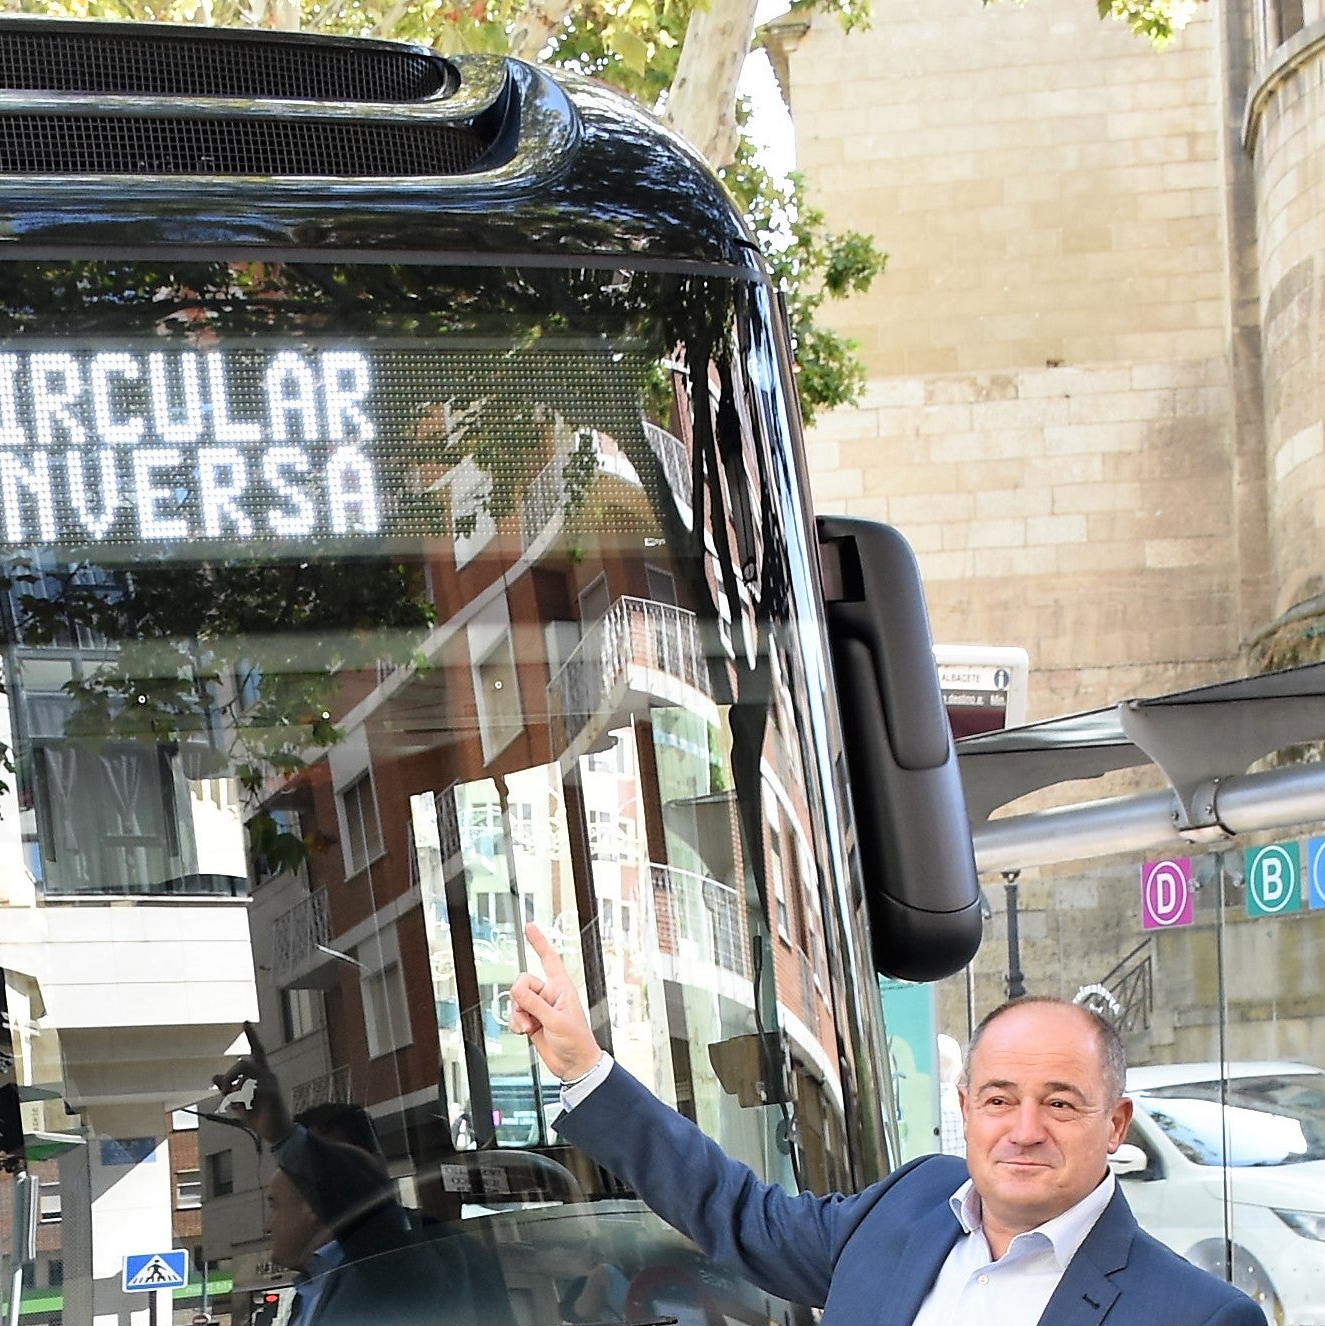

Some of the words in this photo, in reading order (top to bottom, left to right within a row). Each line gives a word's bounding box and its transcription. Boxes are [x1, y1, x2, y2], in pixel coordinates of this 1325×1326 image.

[941, 673, 980, 684] ALBACETE
[1155, 872, 1176, 915] D
[1261, 856, 1284, 901] B
